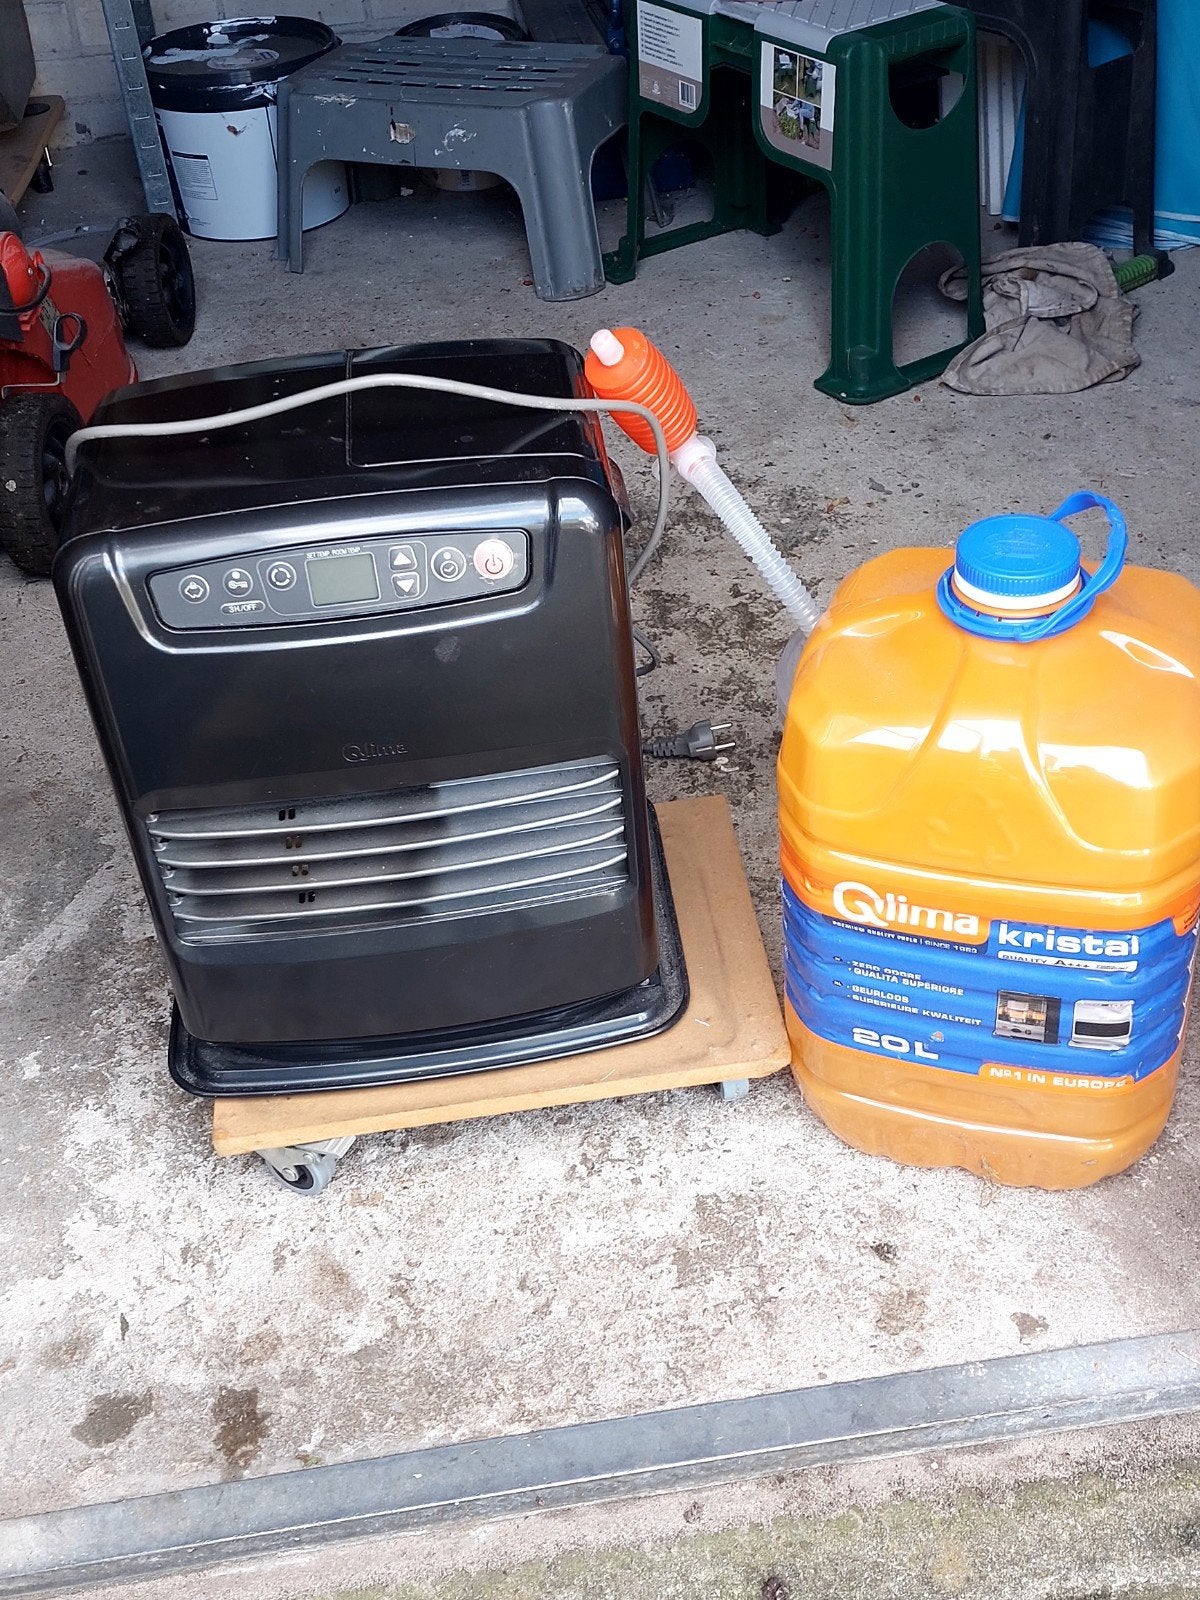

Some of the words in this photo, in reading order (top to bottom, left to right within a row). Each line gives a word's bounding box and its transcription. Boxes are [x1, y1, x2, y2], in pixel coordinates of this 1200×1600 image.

[832, 881, 979, 937] Qlima
[1002, 954, 1048, 964] QUALITY
[851, 960, 881, 972] ZERO
[883, 968, 922, 981] ODORE
[851, 985, 910, 1004] GEURLOOS
[902, 978, 965, 996] SUPERIORE
[851, 994, 919, 1014] SUPERIEURE
[922, 1009, 982, 1026] KWALITEIT
[1027, 1072, 1046, 1084] IN
